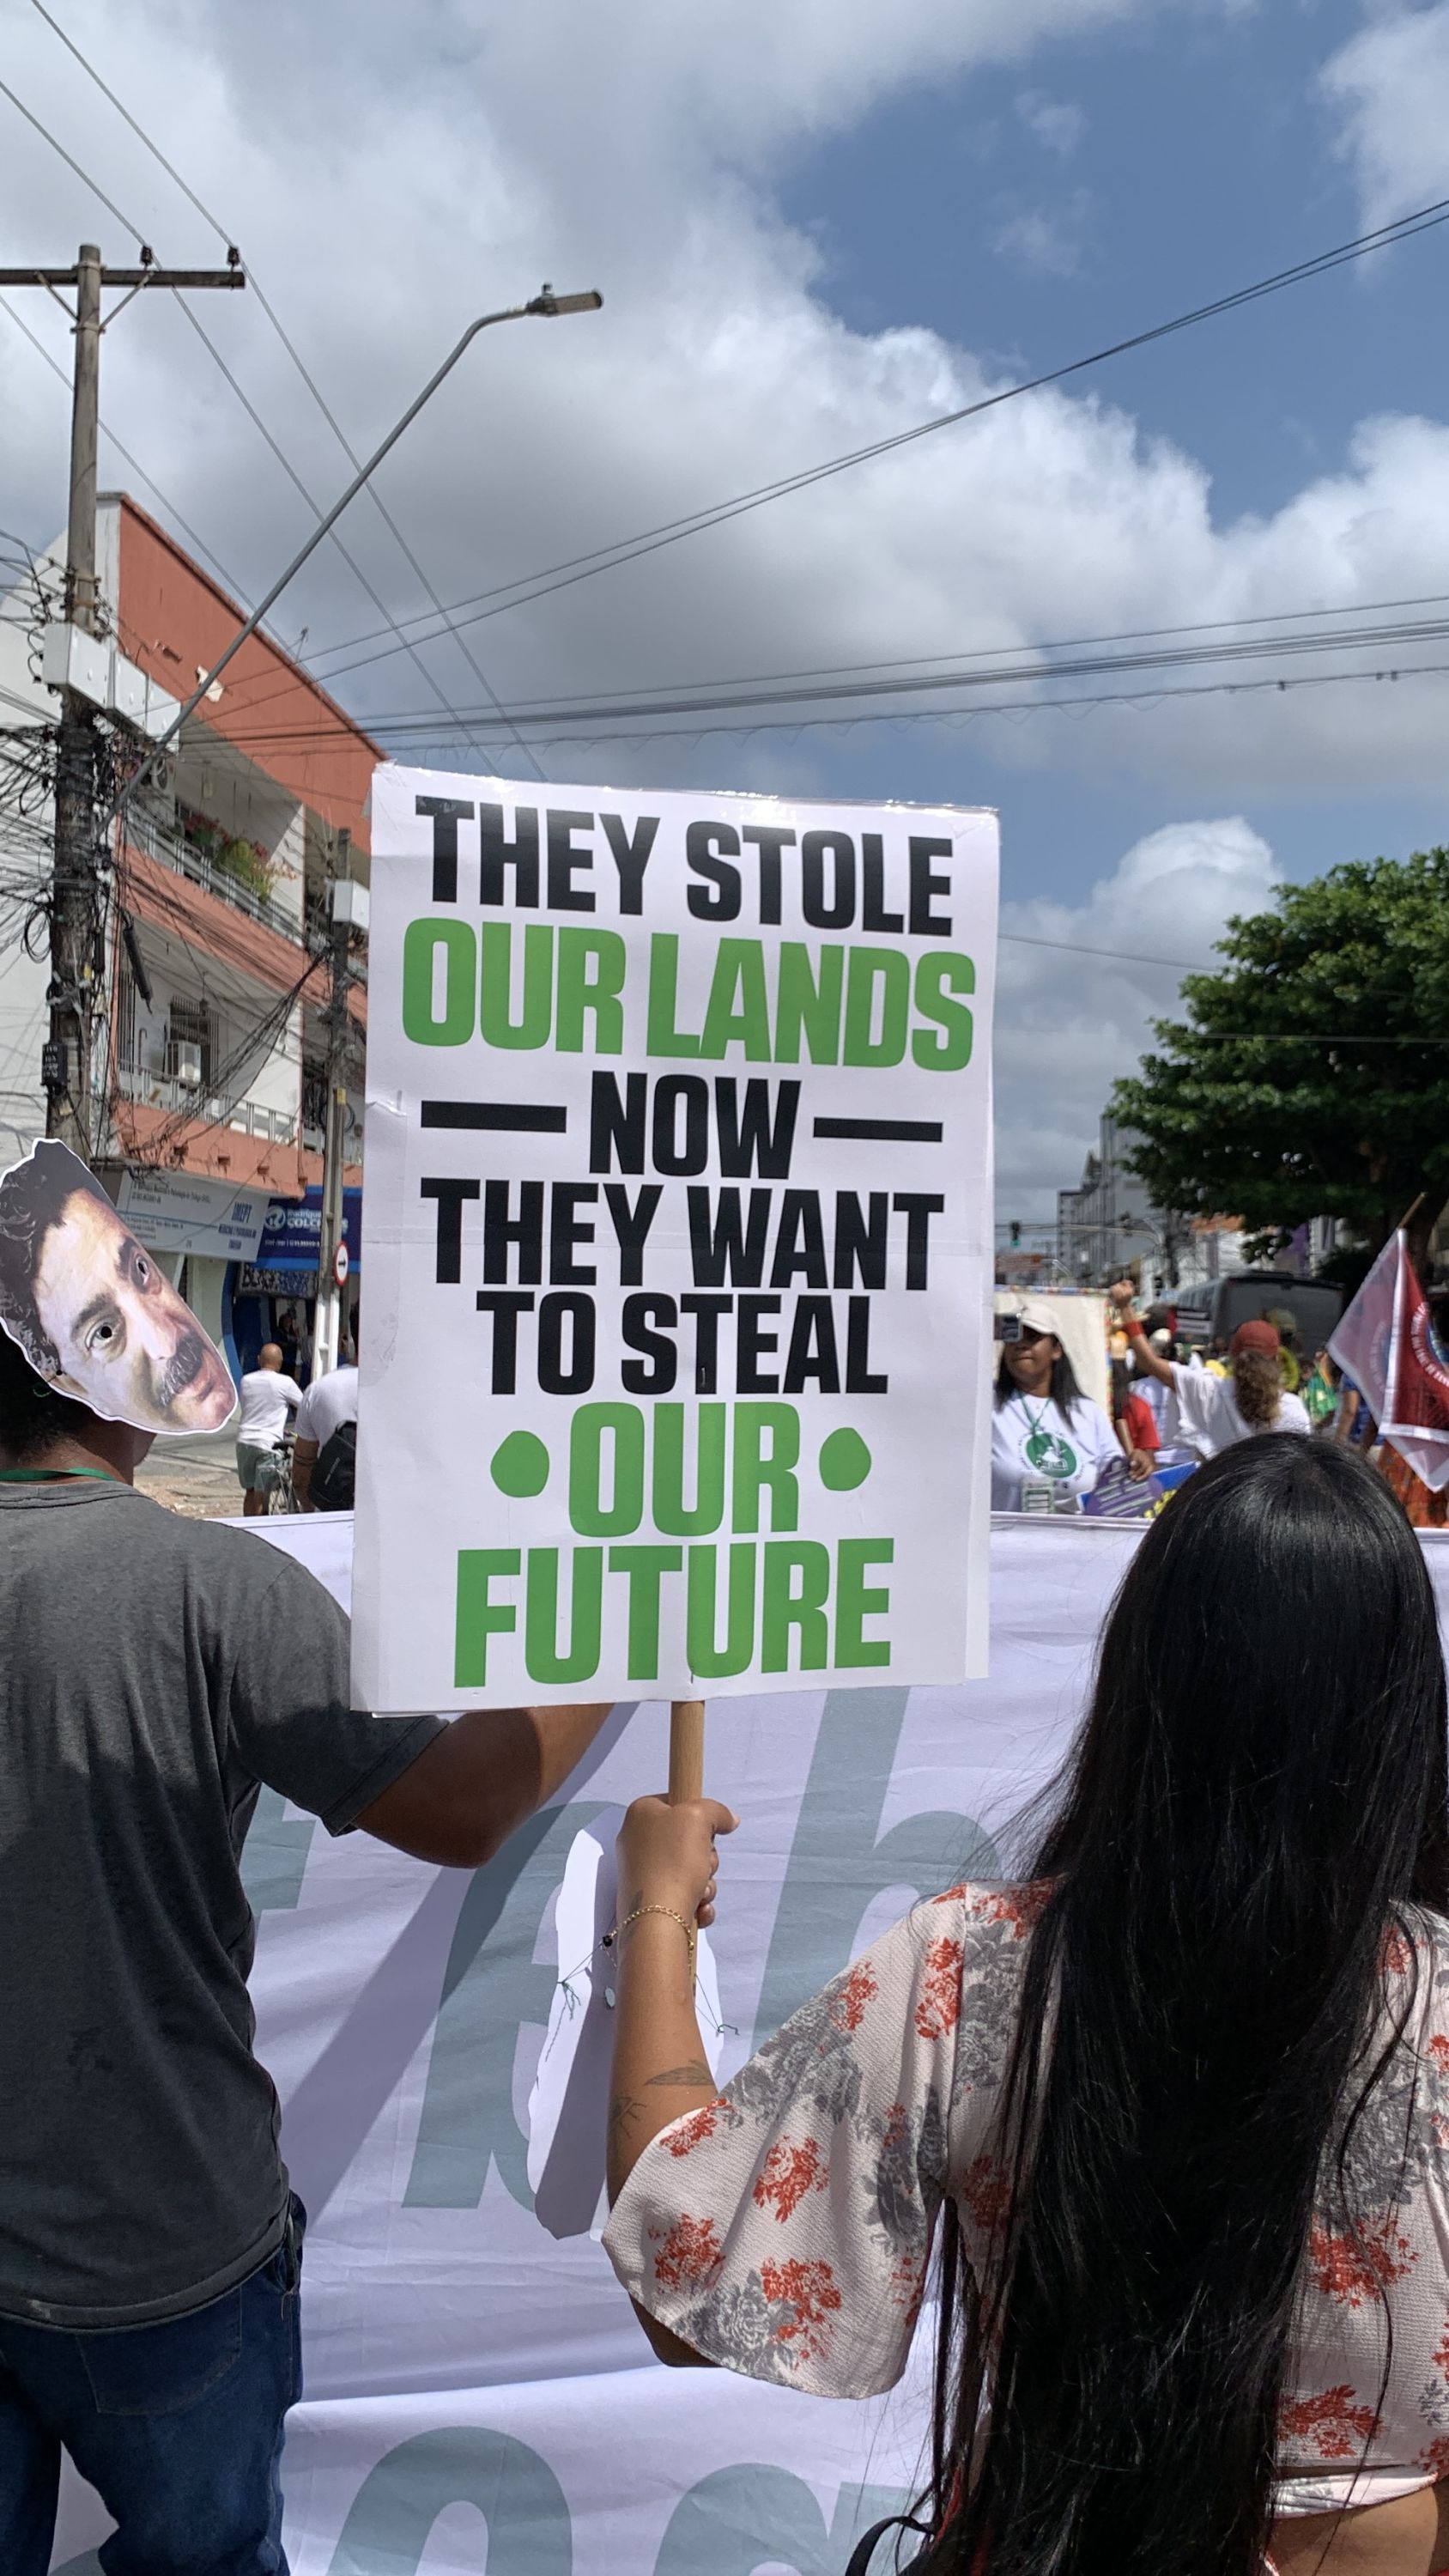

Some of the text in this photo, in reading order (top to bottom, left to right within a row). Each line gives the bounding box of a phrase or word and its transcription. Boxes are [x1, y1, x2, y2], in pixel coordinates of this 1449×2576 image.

[415, 795, 953, 937] THEY STOLE
[403, 917, 975, 1071] OUR LANDS
[590, 1072, 801, 1179] NOW
[421, 1178, 943, 1290] THEY WANT
[476, 1291, 888, 1394] TO STEAL
[571, 1403, 798, 1536] OUR
[457, 1540, 892, 1686] FUTURE
